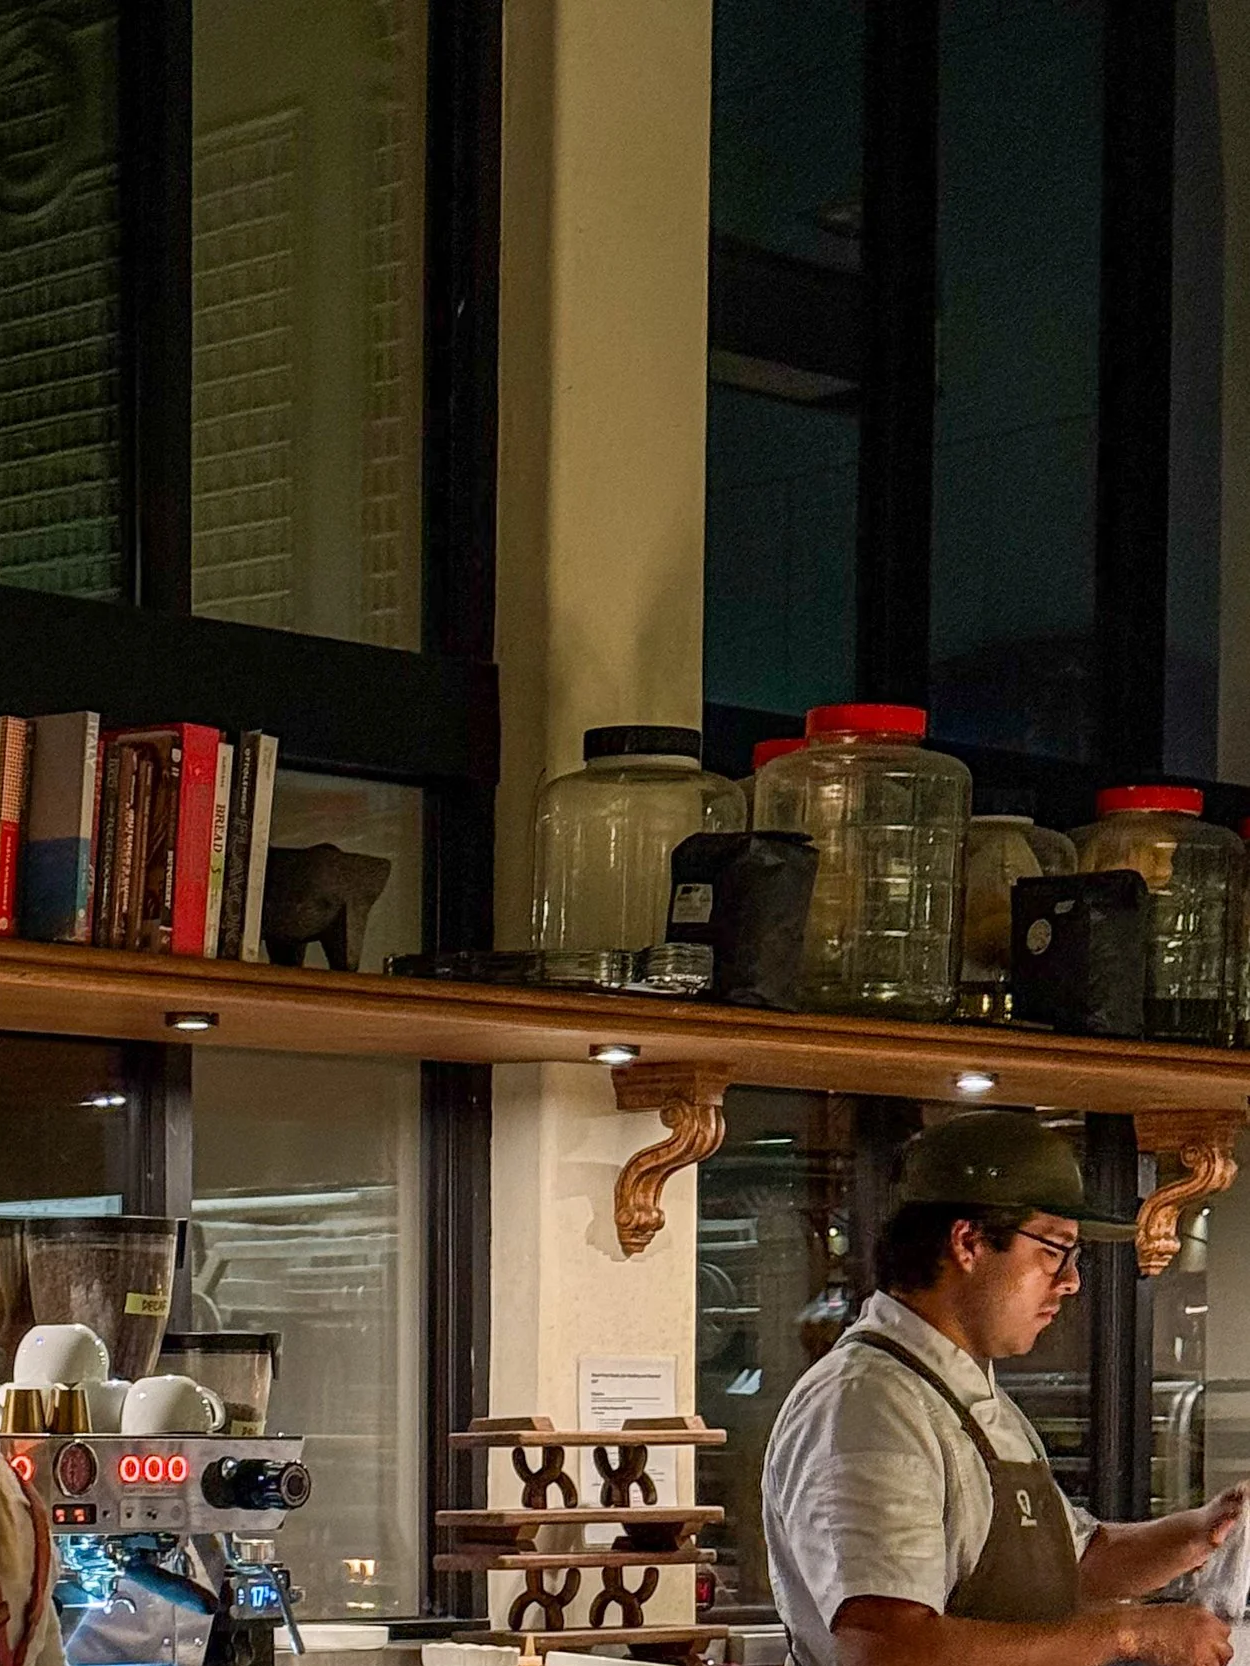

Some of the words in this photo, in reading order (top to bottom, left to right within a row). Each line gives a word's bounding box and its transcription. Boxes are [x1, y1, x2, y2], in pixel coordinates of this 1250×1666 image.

[85, 719, 99, 769] ITALY
[213, 803, 227, 854] BREAD
[119, 1454, 188, 1483] 000
